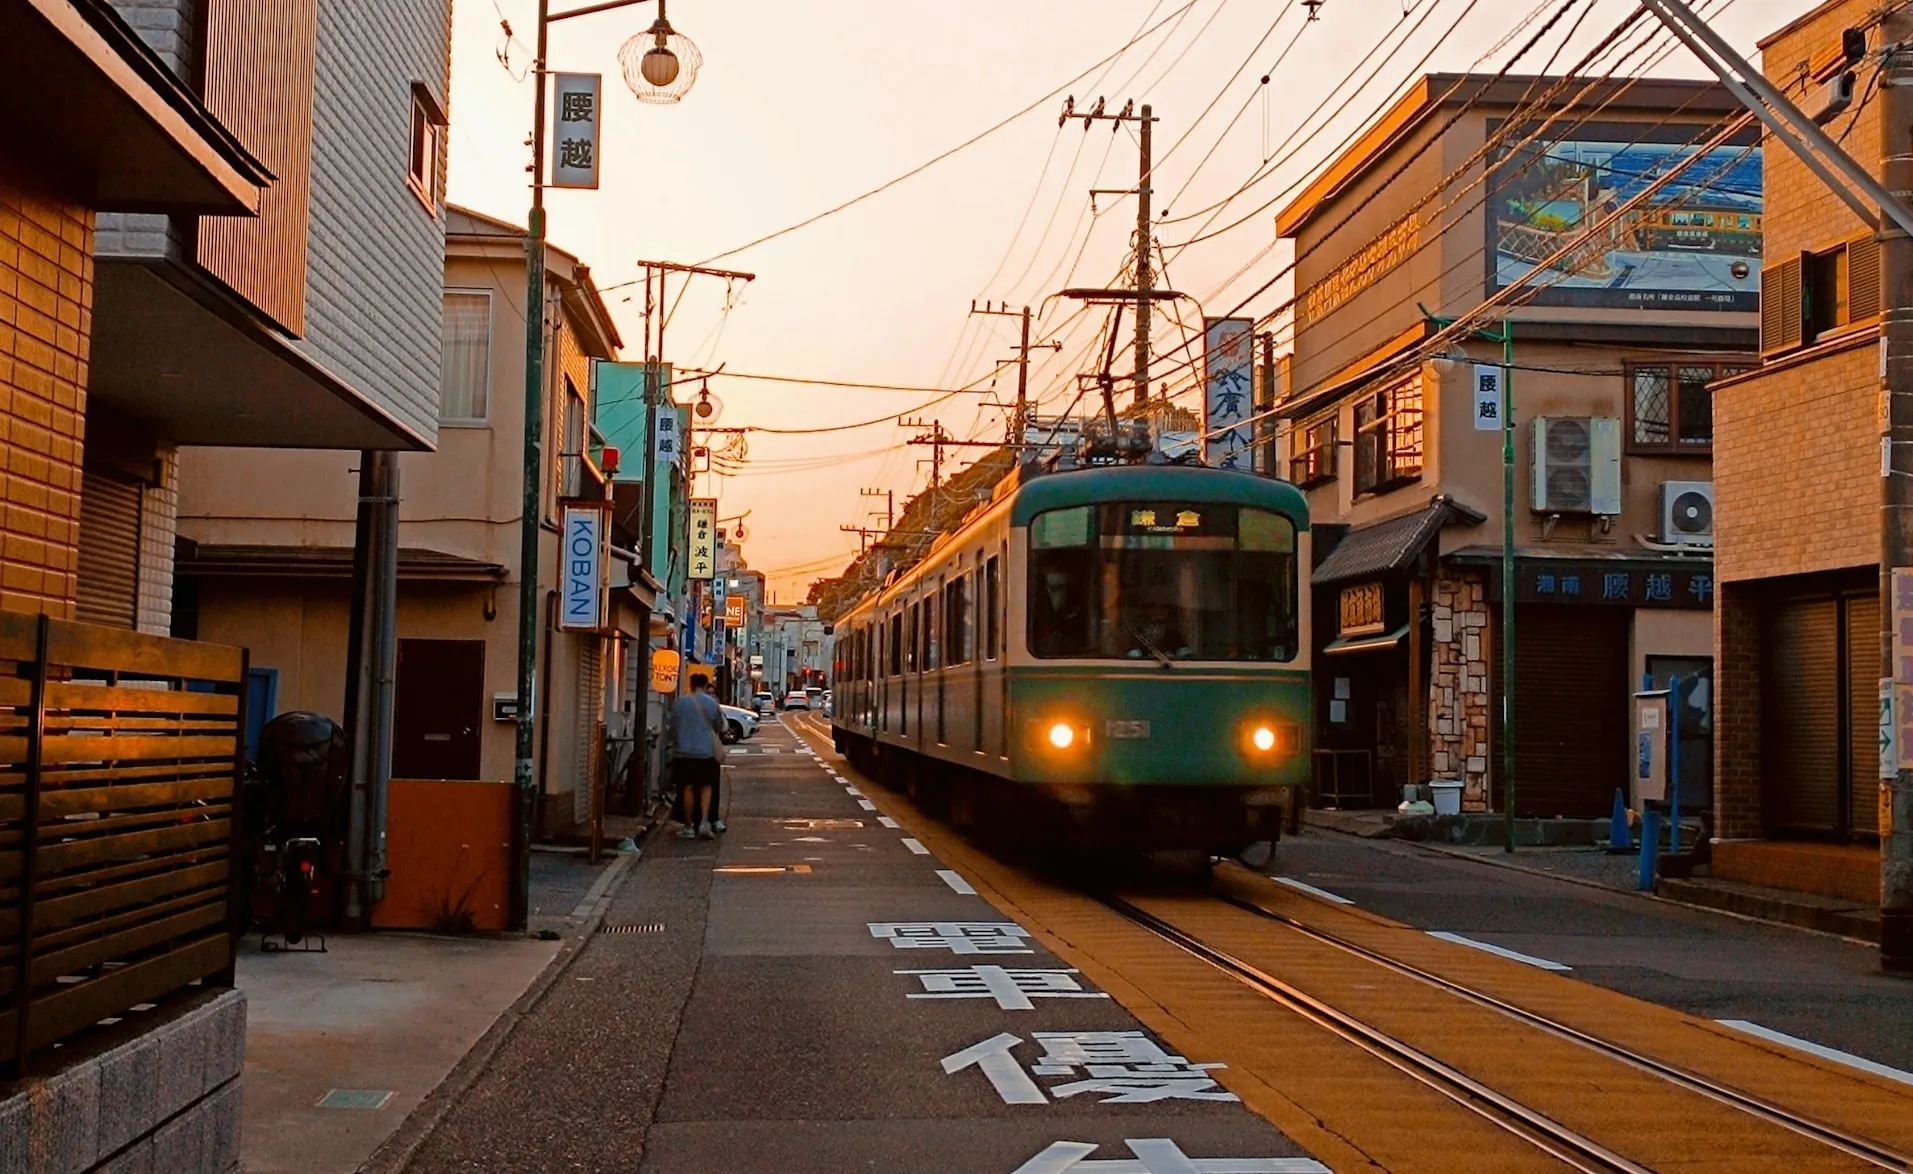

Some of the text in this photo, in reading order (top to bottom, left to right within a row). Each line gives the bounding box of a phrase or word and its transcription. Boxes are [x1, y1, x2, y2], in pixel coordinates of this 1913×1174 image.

[560, 92, 593, 169] 腰越
[1480, 375, 1497, 418] 腰越
[659, 418, 674, 452] 腰越
[569, 520, 593, 615] KOBAN
